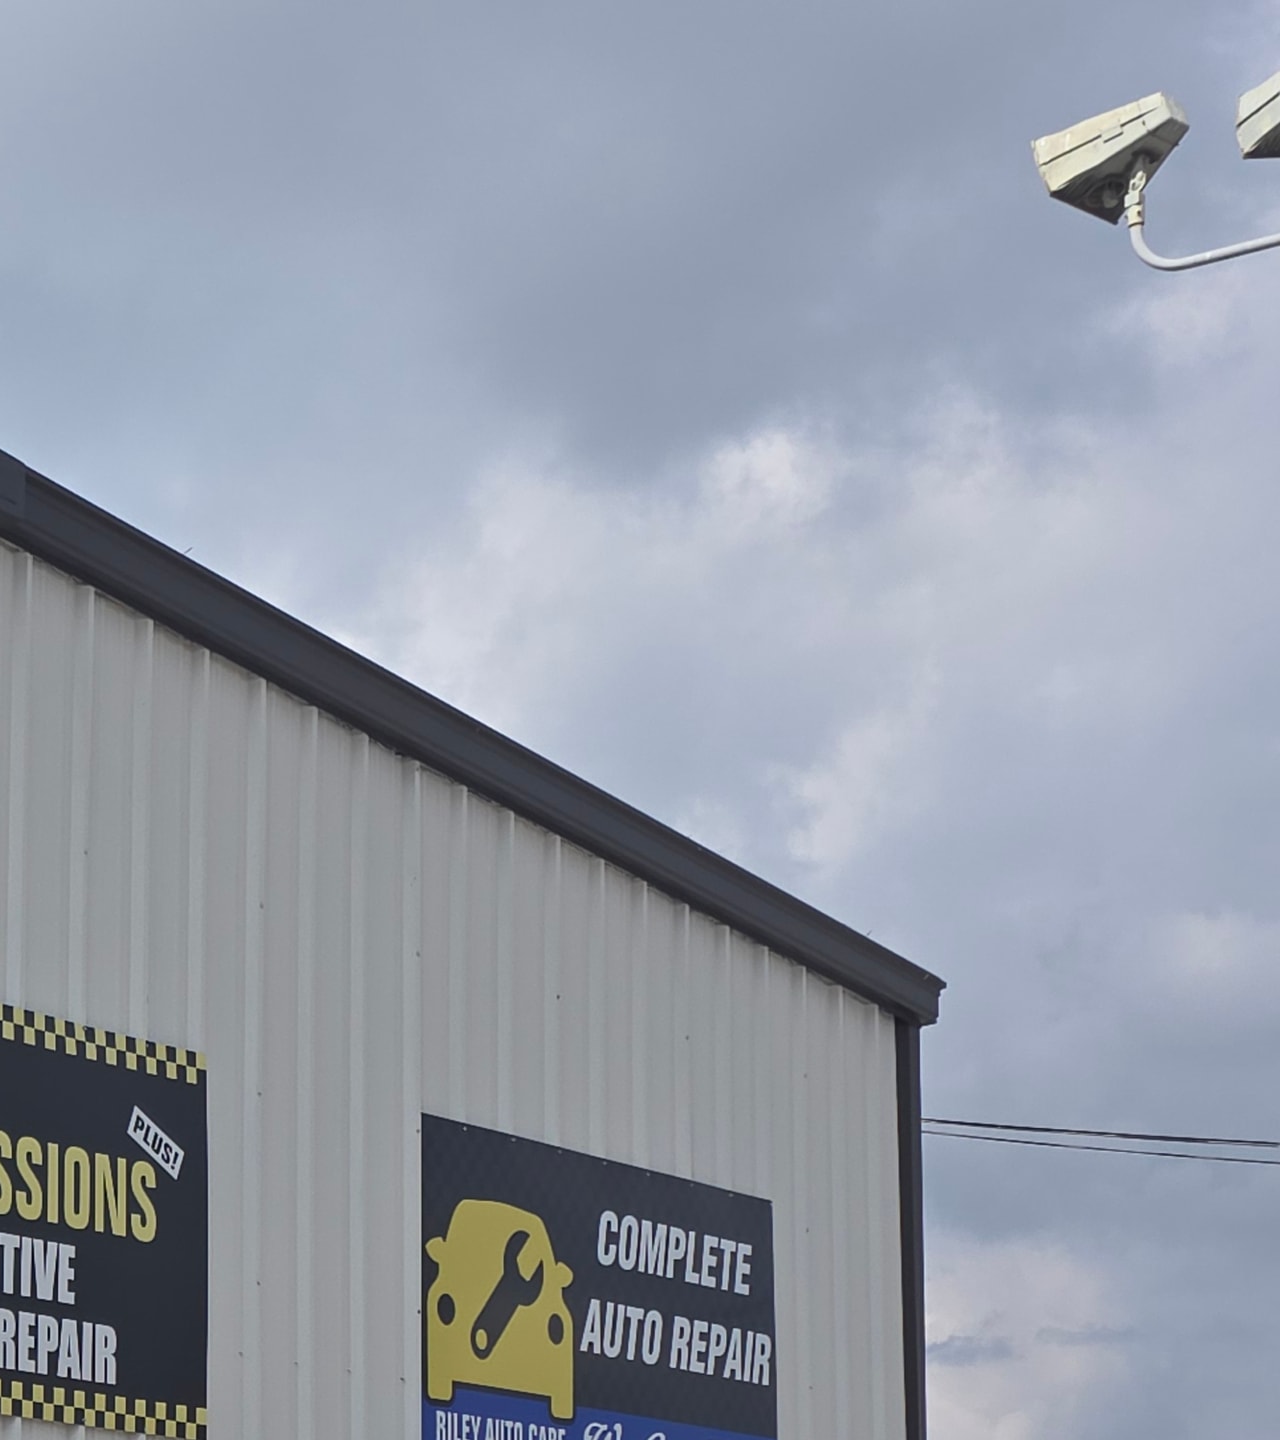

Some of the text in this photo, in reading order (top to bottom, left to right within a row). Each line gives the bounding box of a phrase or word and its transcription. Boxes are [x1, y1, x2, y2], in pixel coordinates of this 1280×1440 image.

[132, 1113, 182, 1171] PLUS!
[597, 1210, 753, 1296] COMPLETE
[580, 1298, 772, 1386] AUTO REPAIR
